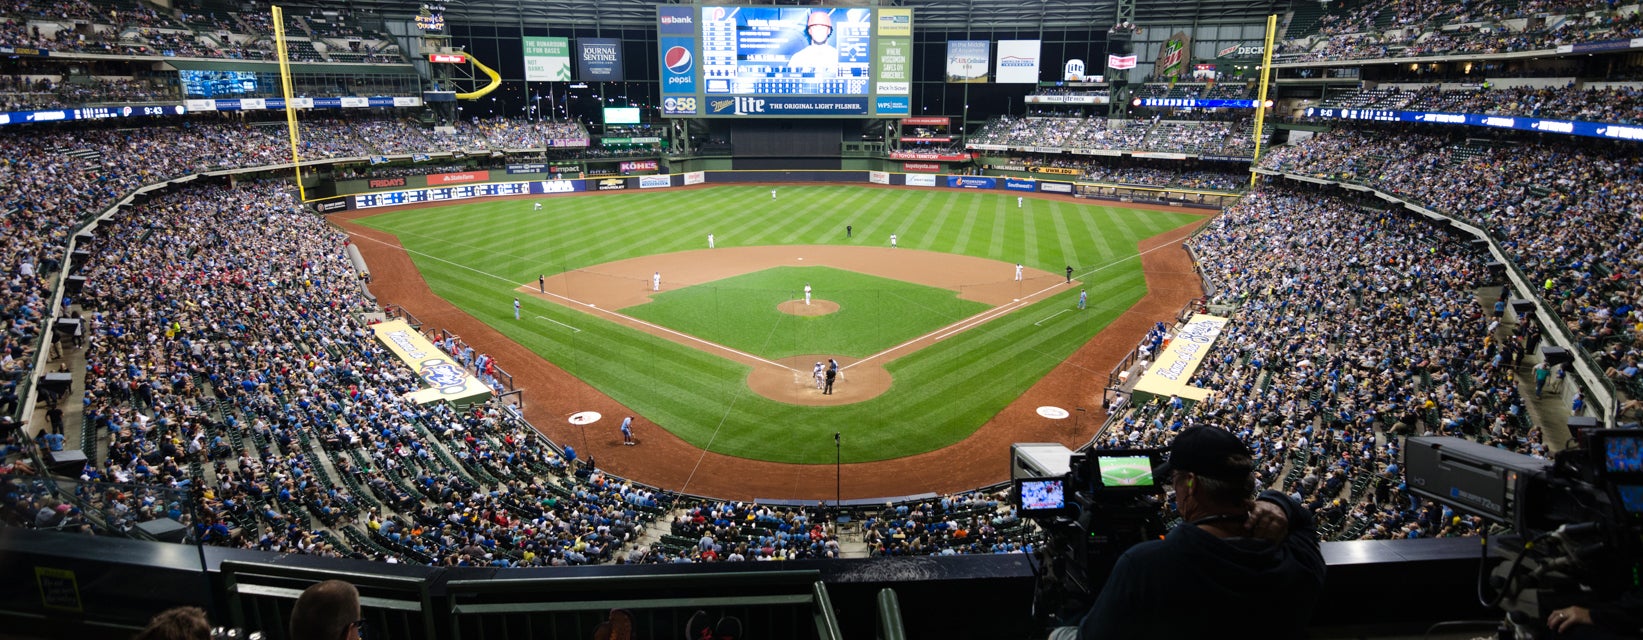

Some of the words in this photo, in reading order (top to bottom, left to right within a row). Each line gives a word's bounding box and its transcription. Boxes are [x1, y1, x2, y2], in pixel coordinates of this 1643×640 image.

[1237, 46, 1264, 55] DECK
[1067, 63, 1083, 74] Lite
[669, 76, 692, 85] pepsi
[676, 97, 696, 111] 58
[734, 96, 766, 116] Lite
[144, 107, 163, 115] 9:43
[557, 166, 580, 174] impact
[370, 178, 405, 188] FRIDAYS
